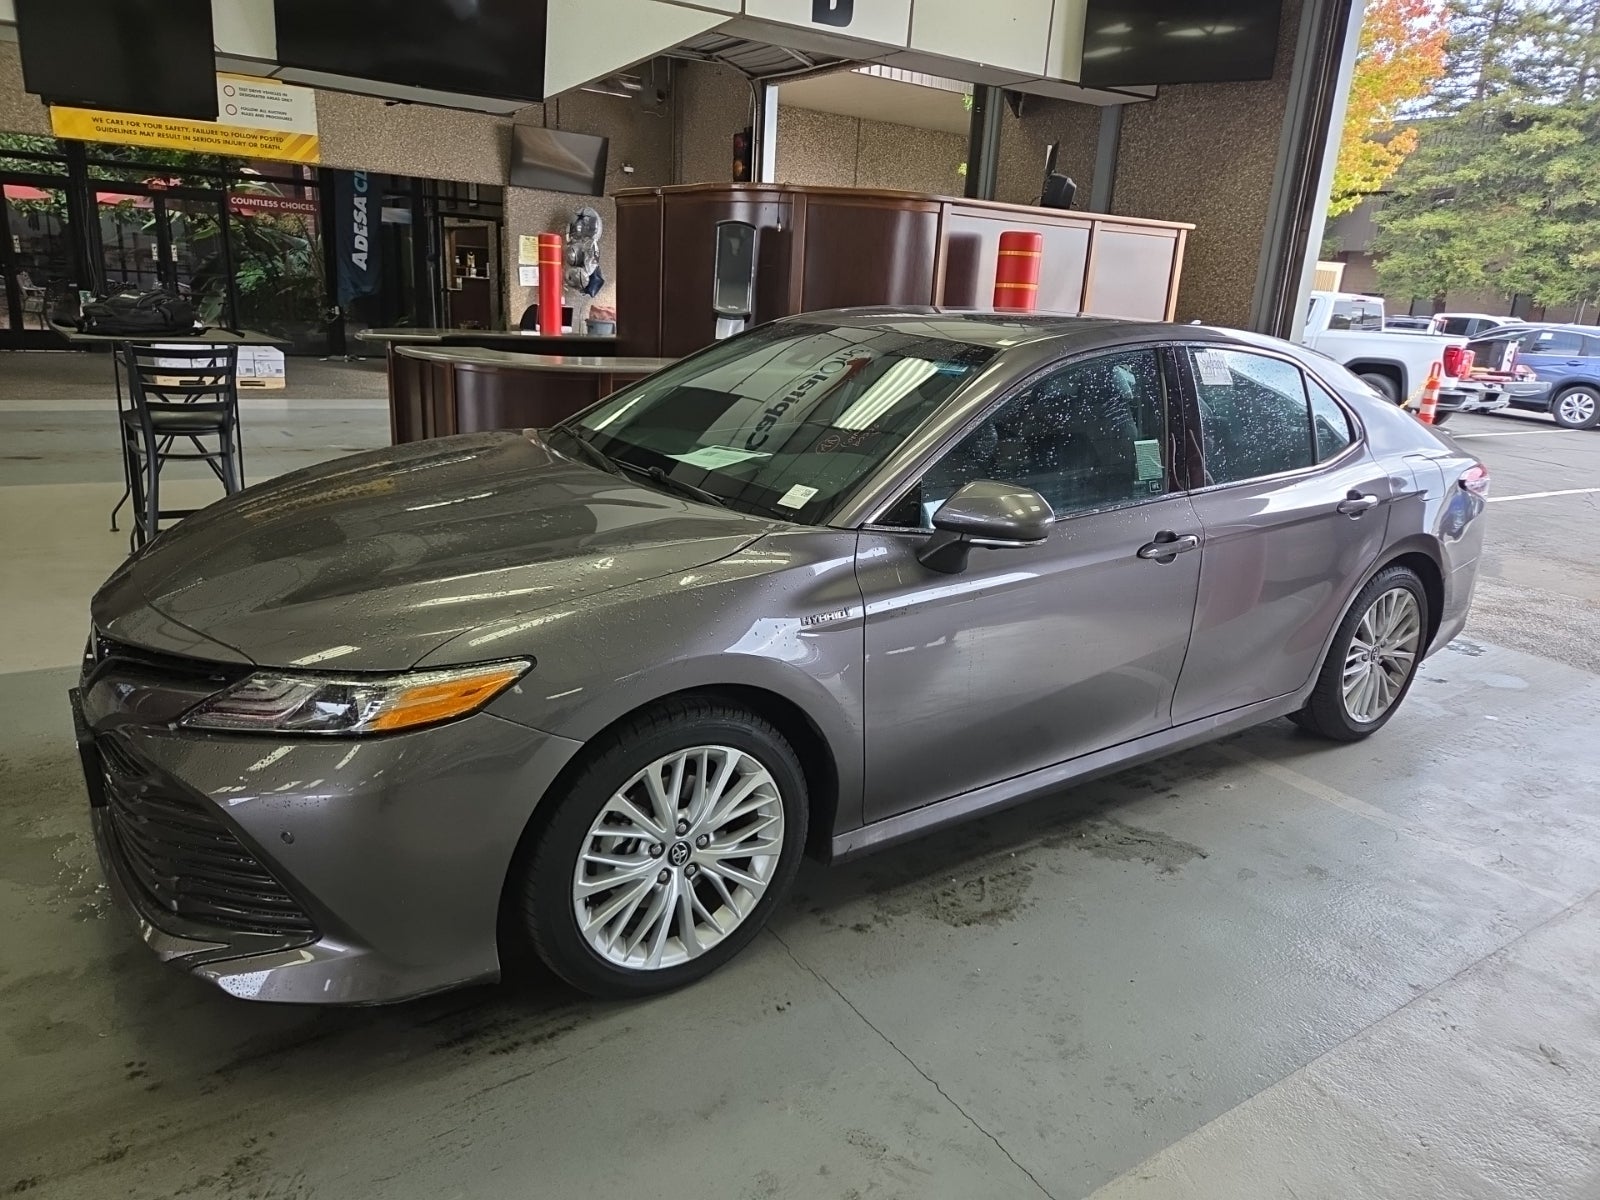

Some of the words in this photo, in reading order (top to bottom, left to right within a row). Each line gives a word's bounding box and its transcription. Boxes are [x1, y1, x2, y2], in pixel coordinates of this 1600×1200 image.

[91, 116, 104, 124] WE
[105, 118, 124, 126] CARE
[126, 120, 141, 128] FOR
[142, 122, 163, 130] YOUR
[192, 127, 218, 136] FAILURE
[231, 131, 258, 140] FOLLOW
[259, 135, 284, 143] POSTED
[95, 125, 137, 135] GUIDELINES
[157, 132, 181, 140] RESULT
[192, 136, 221, 144] SERIOUS
[222, 139, 246, 147] INJURY
[230, 196, 279, 208] COUNTLESS
[280, 201, 317, 212] CHOICES.
[351, 196, 369, 272] ADESA
[800, 606, 853, 627] HYBRID
